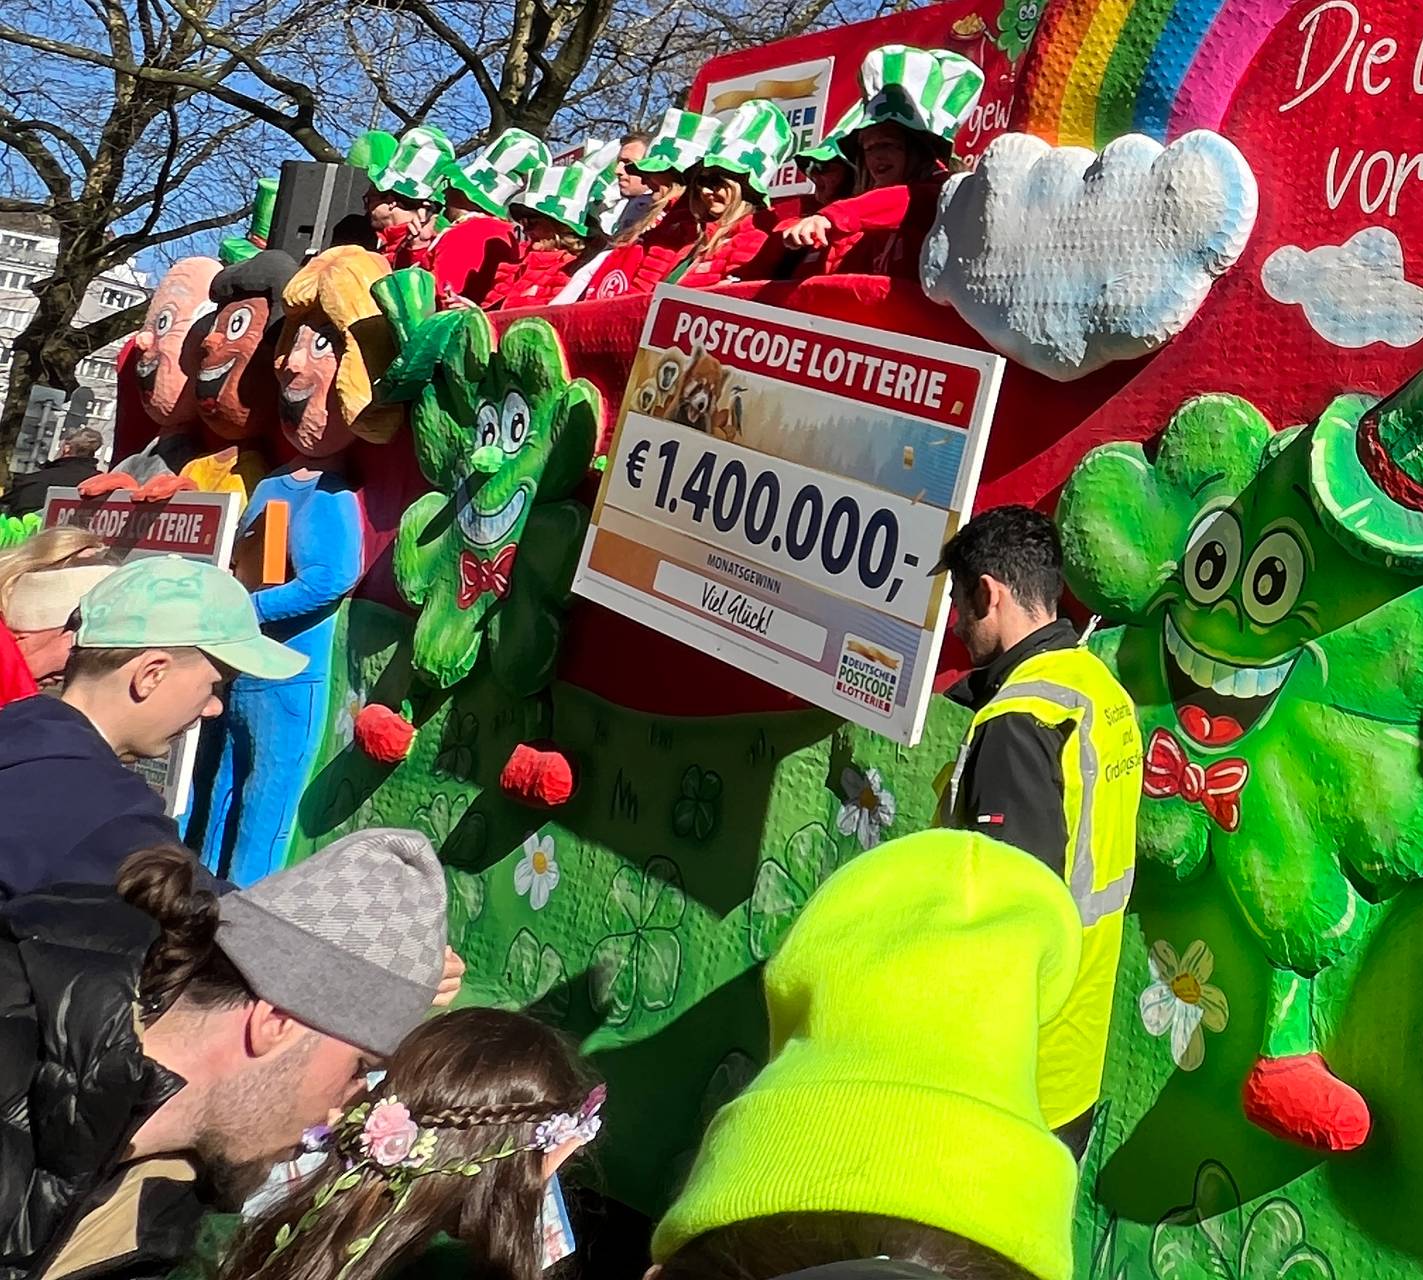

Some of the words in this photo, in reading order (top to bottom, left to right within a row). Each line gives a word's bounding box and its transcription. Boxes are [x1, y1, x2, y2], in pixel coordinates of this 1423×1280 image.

[1279, 0, 1397, 112] Die
[673, 312, 808, 373] POSTCODE
[807, 343, 947, 409] LOTTERIE
[707, 553, 782, 594] MONATSGEWINN
[702, 582, 729, 616] Viel
[727, 594, 774, 635] Glück!
[838, 665, 894, 702] POSTCODE
[848, 657, 890, 682] DEUTSCHE
[842, 684, 885, 710] LOTTERIE
